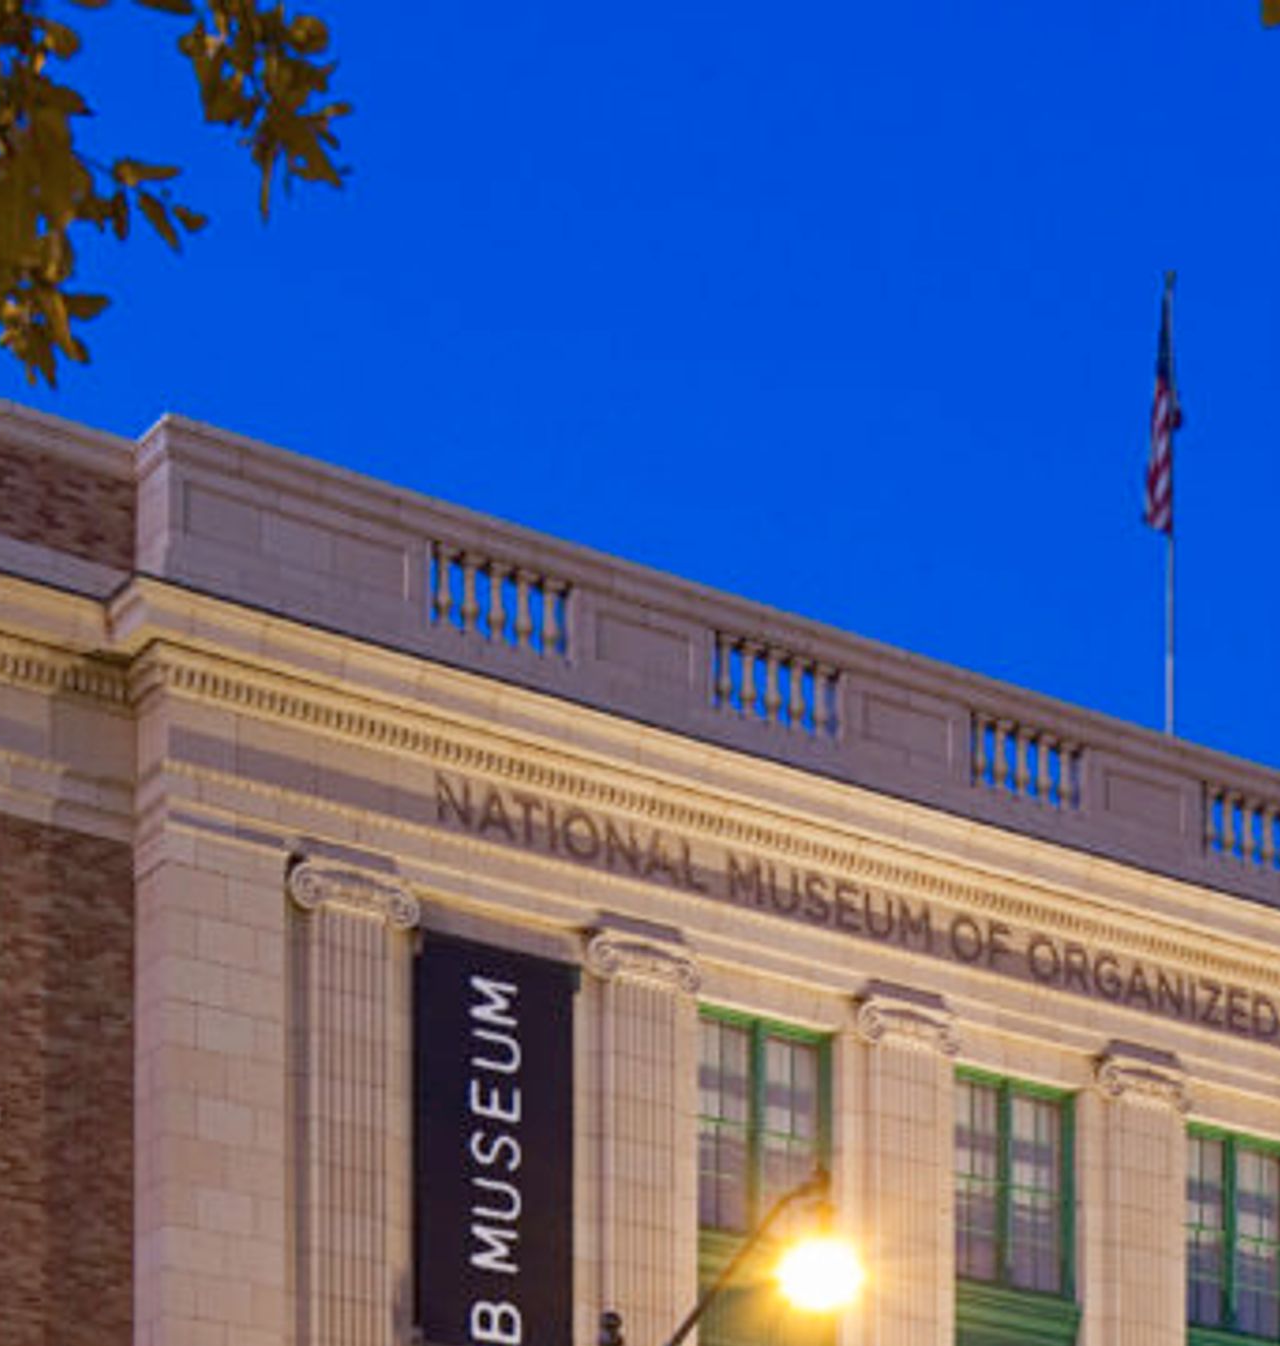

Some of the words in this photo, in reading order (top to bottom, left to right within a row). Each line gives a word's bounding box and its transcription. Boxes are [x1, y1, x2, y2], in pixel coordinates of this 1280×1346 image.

[433, 770, 708, 894] NATIONAL
[725, 850, 932, 950] MUSEUM
[949, 912, 1011, 968] OF
[1026, 932, 1279, 1039] ORGANIZED
[470, 976, 521, 1274] MUSEUM
